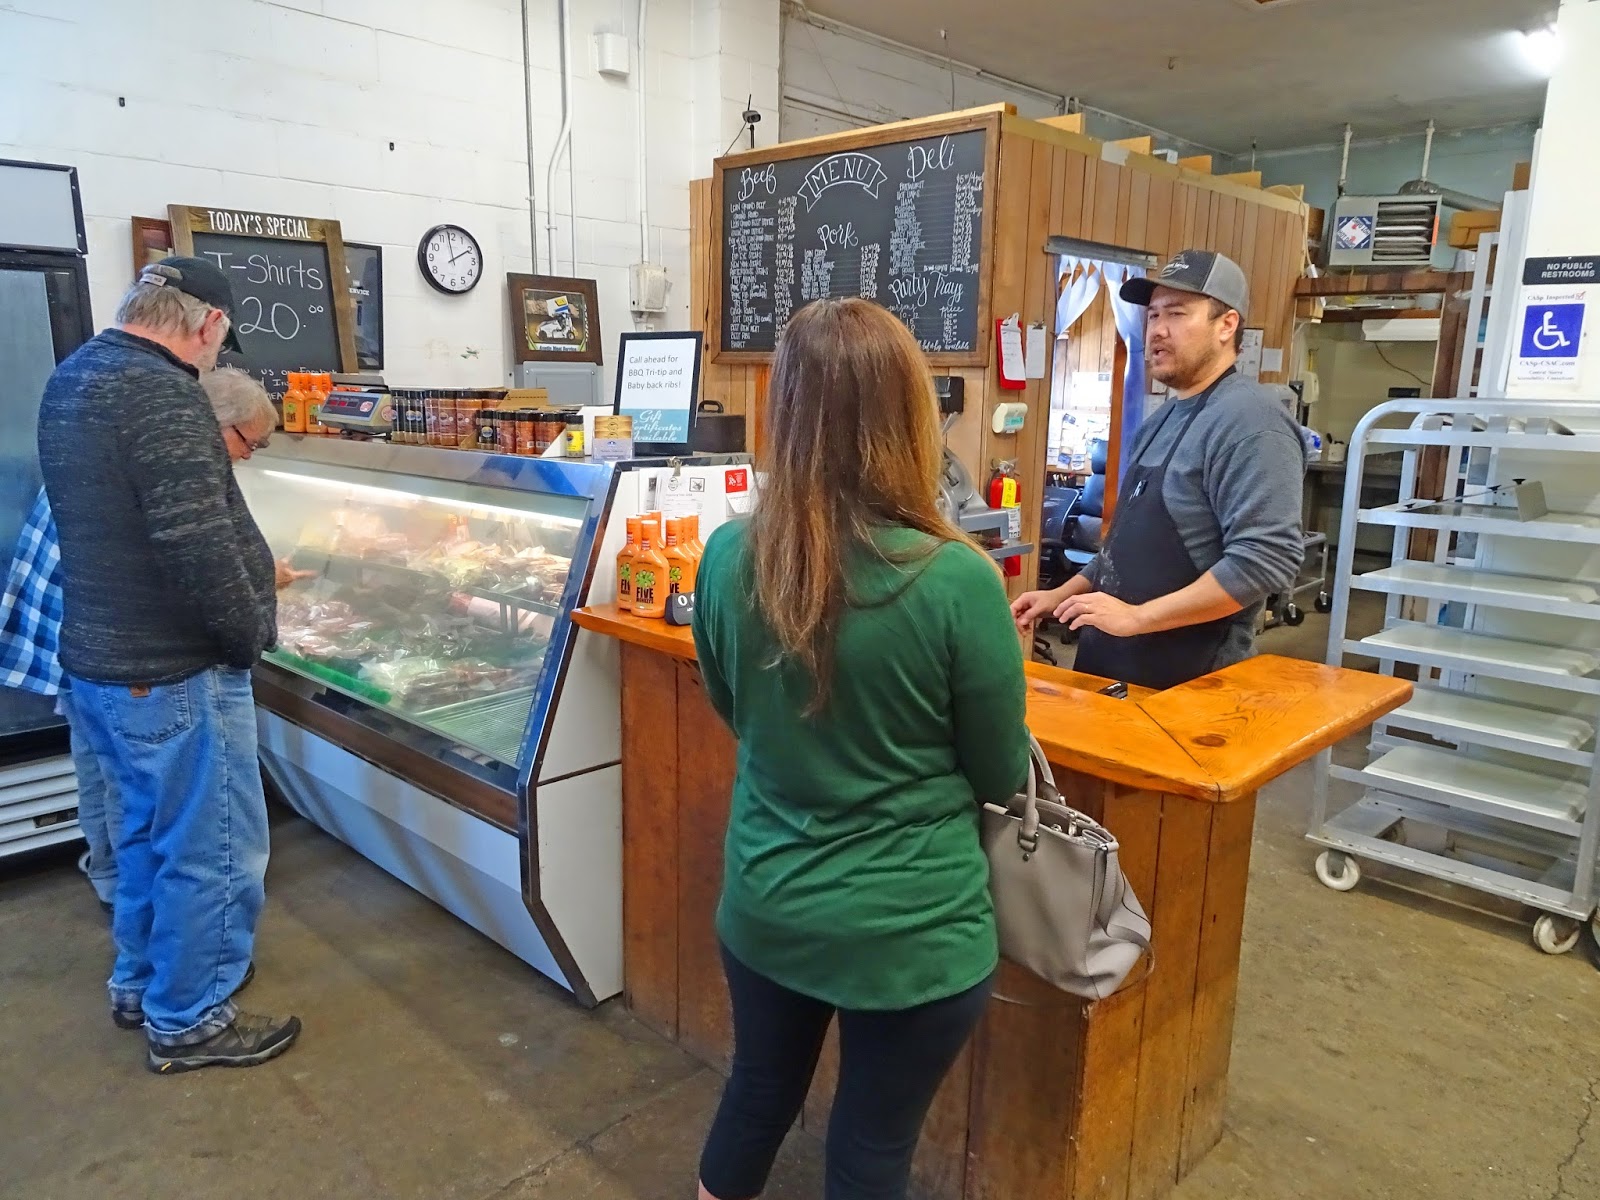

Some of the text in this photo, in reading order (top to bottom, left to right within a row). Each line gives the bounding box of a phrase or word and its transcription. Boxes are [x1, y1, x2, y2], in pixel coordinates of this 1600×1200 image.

[907, 135, 954, 182] Deli
[738, 163, 777, 201] Beef
[811, 157, 872, 192] MENU
[207, 210, 311, 239] TODAY'S SPECIAL
[817, 222, 859, 251] Pork
[203, 251, 323, 290] T-Shirts
[1541, 269, 1595, 279] RESTROOMS
[1546, 261, 1594, 271] NO PUBLIC
[888, 270, 964, 307] Party Trays
[629, 355, 678, 364] Call ahead for
[628, 368, 683, 377] BBQ Tri-tip and
[627, 381, 681, 390] Baby back ribs!
[633, 420, 682, 433] ertificates
[636, 586, 654, 599] FIVE
